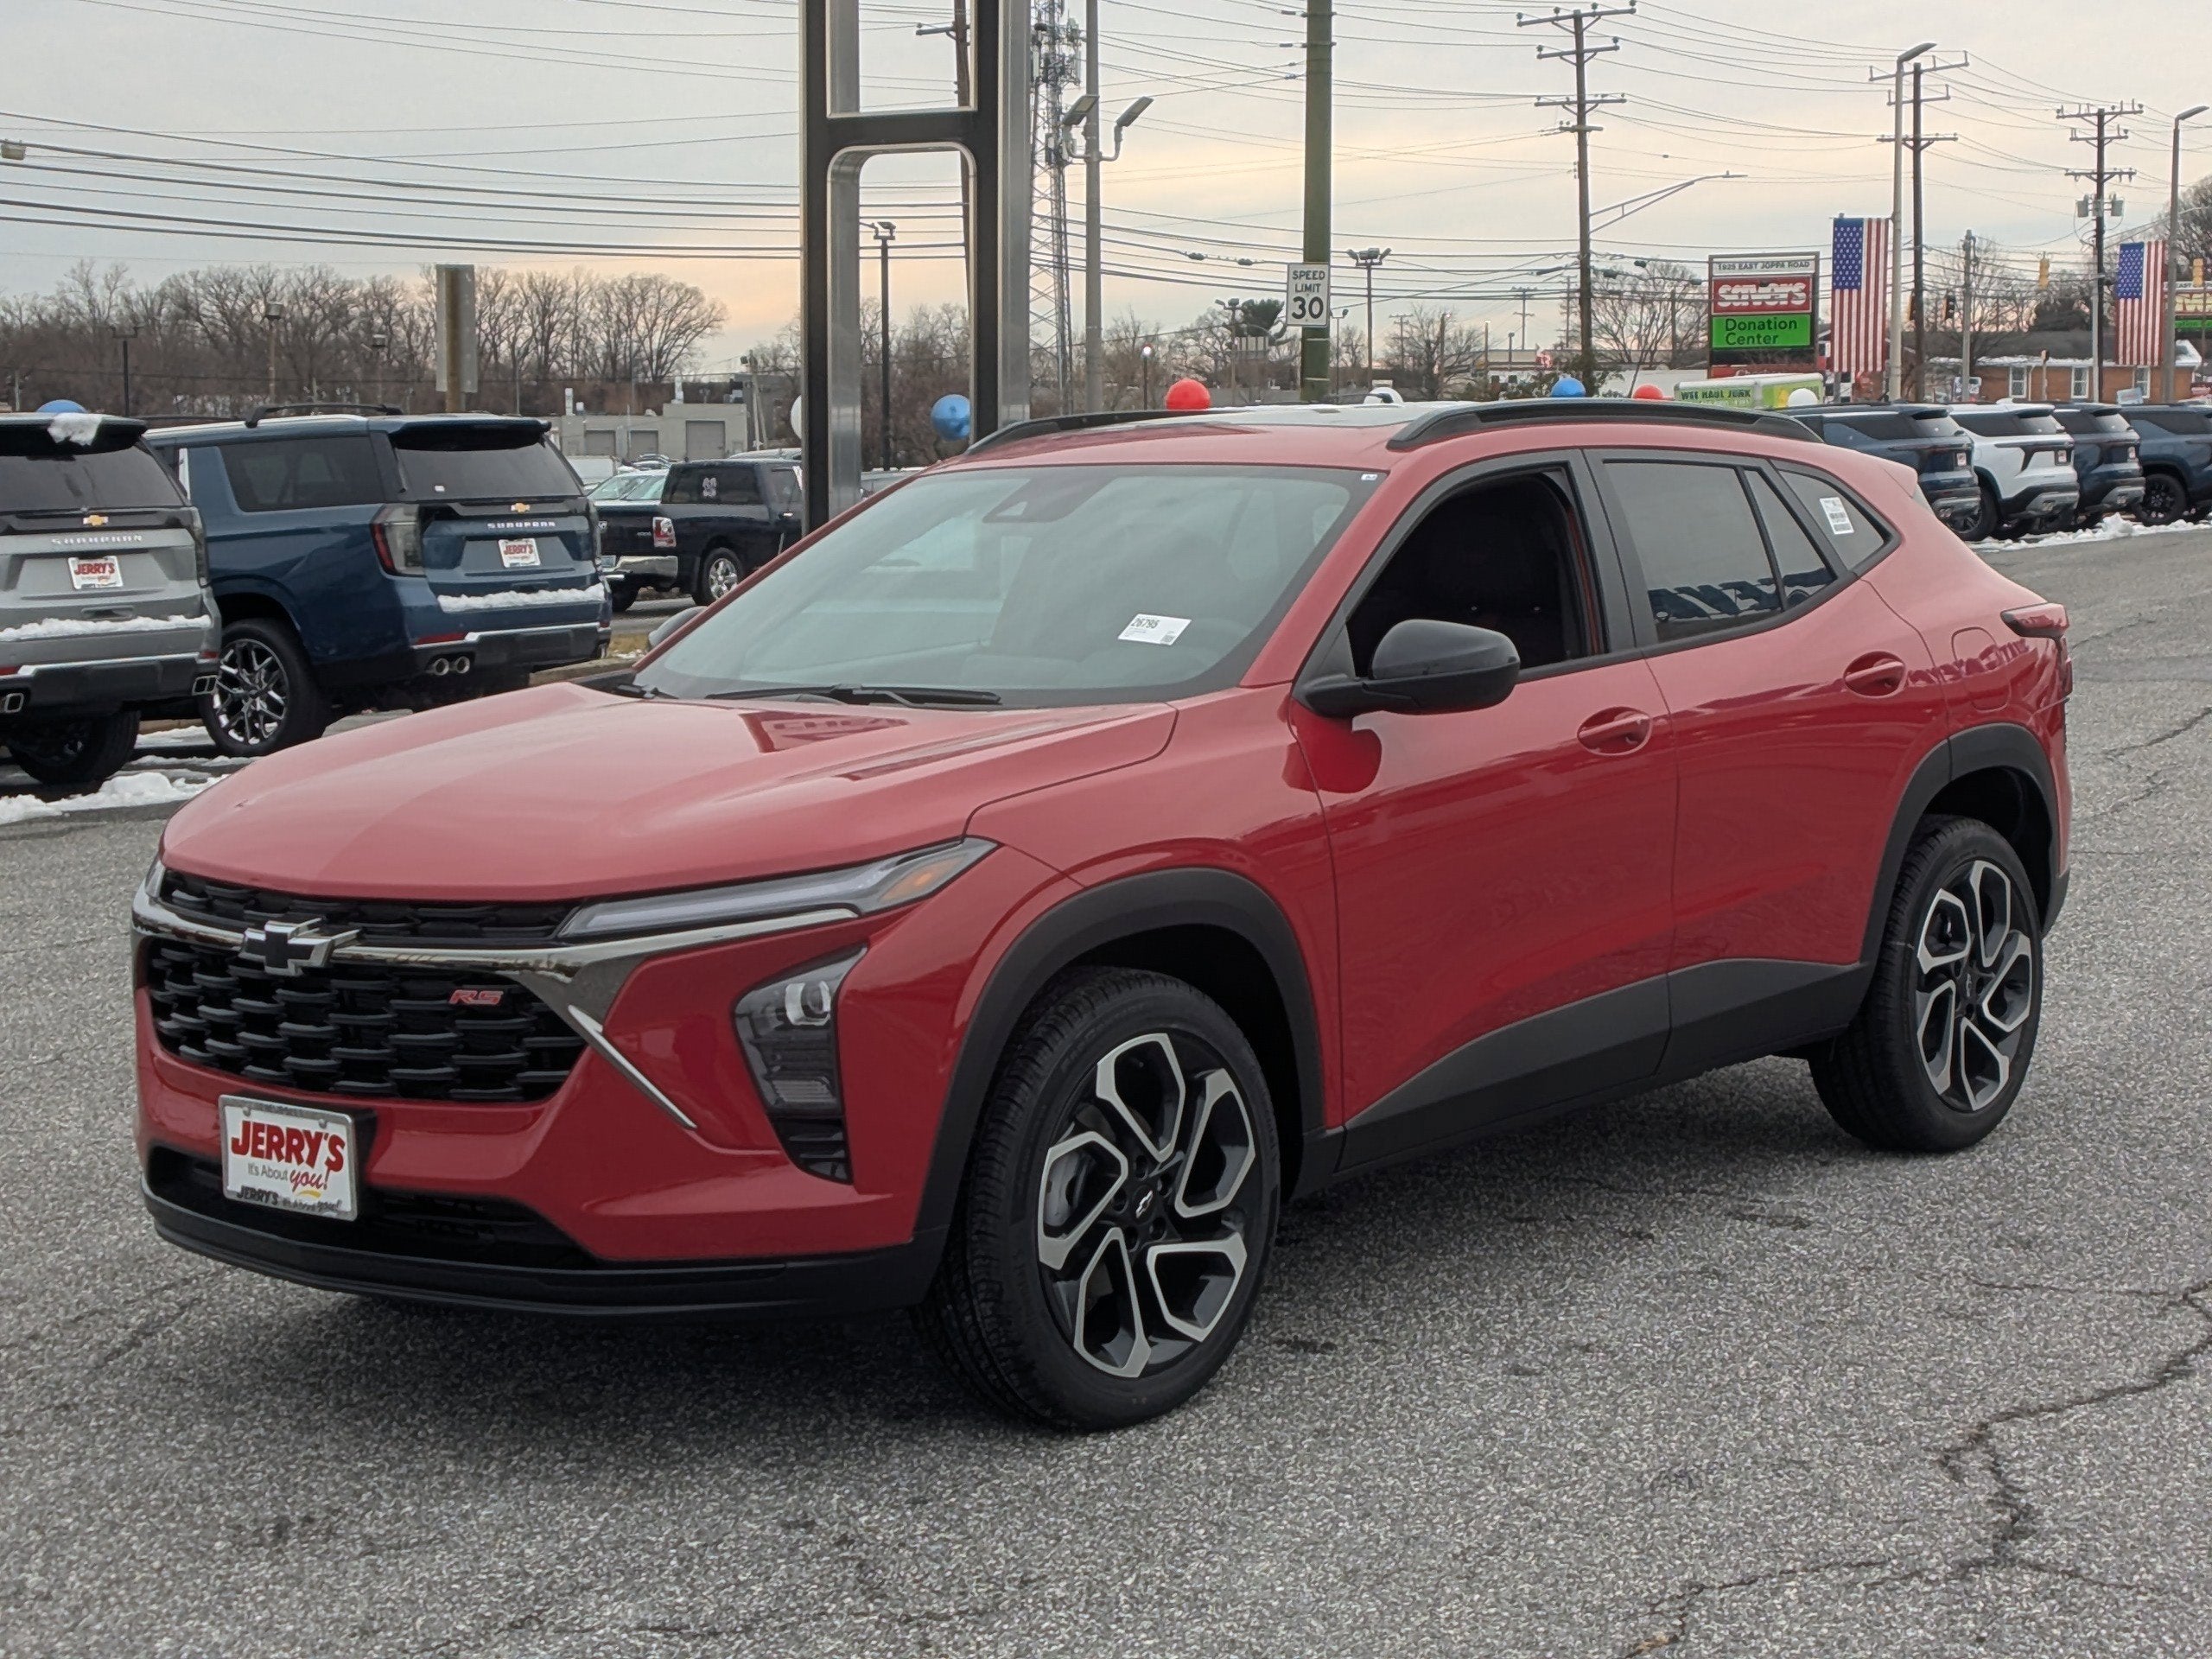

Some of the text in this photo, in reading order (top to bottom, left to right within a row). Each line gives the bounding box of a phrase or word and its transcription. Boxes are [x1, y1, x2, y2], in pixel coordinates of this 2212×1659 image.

[1292, 270, 1325, 280] SPEED
[1294, 283, 1321, 293] LIMIT
[1291, 296, 1324, 320] 30
[1725, 317, 1797, 331] Donation
[1725, 333, 1778, 346] Center
[74, 563, 115, 575] JERRY'S
[449, 989, 504, 1005] RS
[231, 1120, 346, 1173] JERRY'S
[247, 1162, 330, 1193] It's About you!
[236, 1185, 278, 1205] JERRY'S
